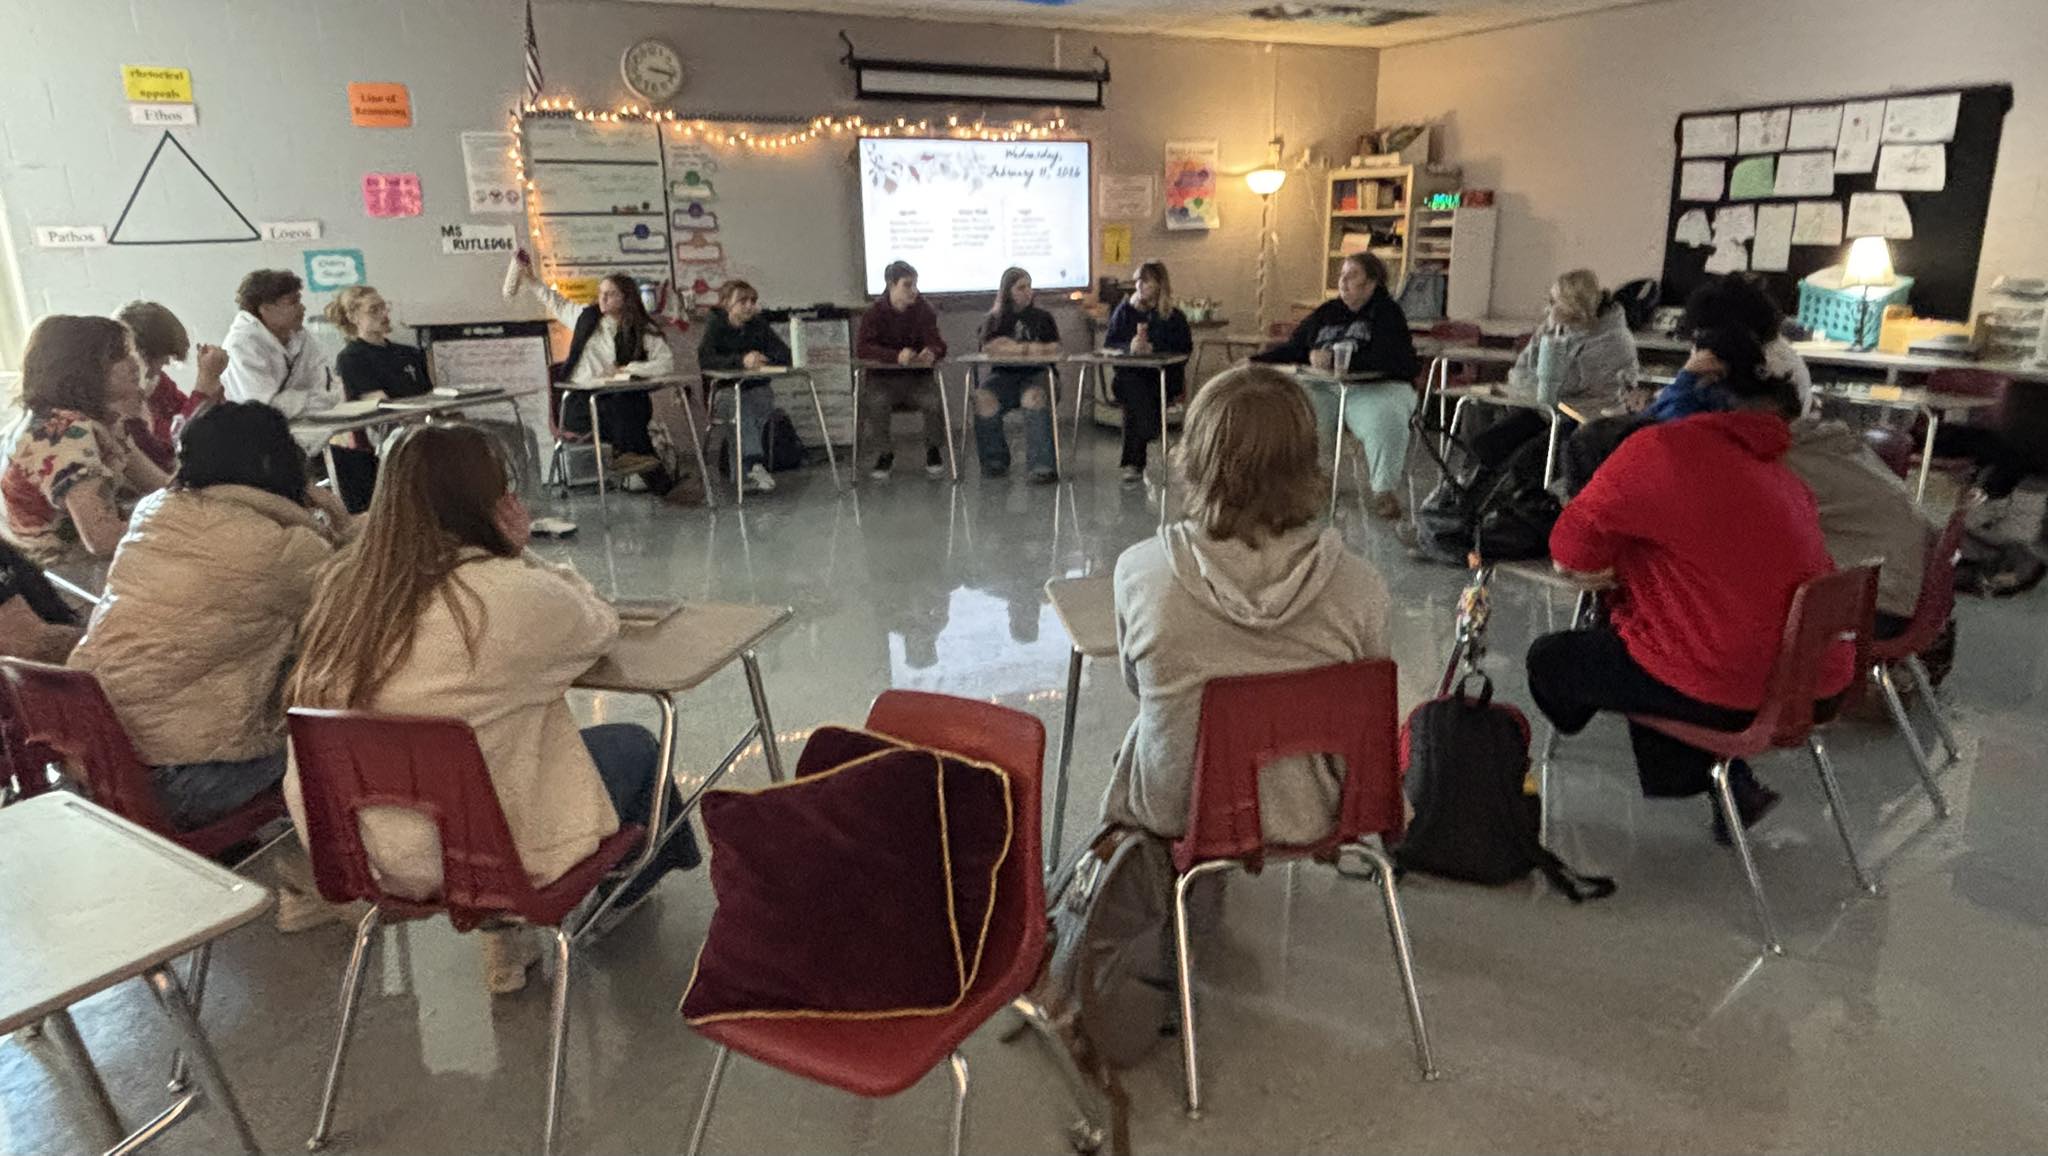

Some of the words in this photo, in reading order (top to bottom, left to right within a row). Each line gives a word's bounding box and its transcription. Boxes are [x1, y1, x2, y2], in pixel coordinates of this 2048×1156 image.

[144, 109, 182, 121] Ethos
[48, 231, 95, 243] Pathos
[270, 227, 312, 239] Logos
[441, 225, 462, 237] MS
[453, 238, 513, 250] RUTLEDGE
